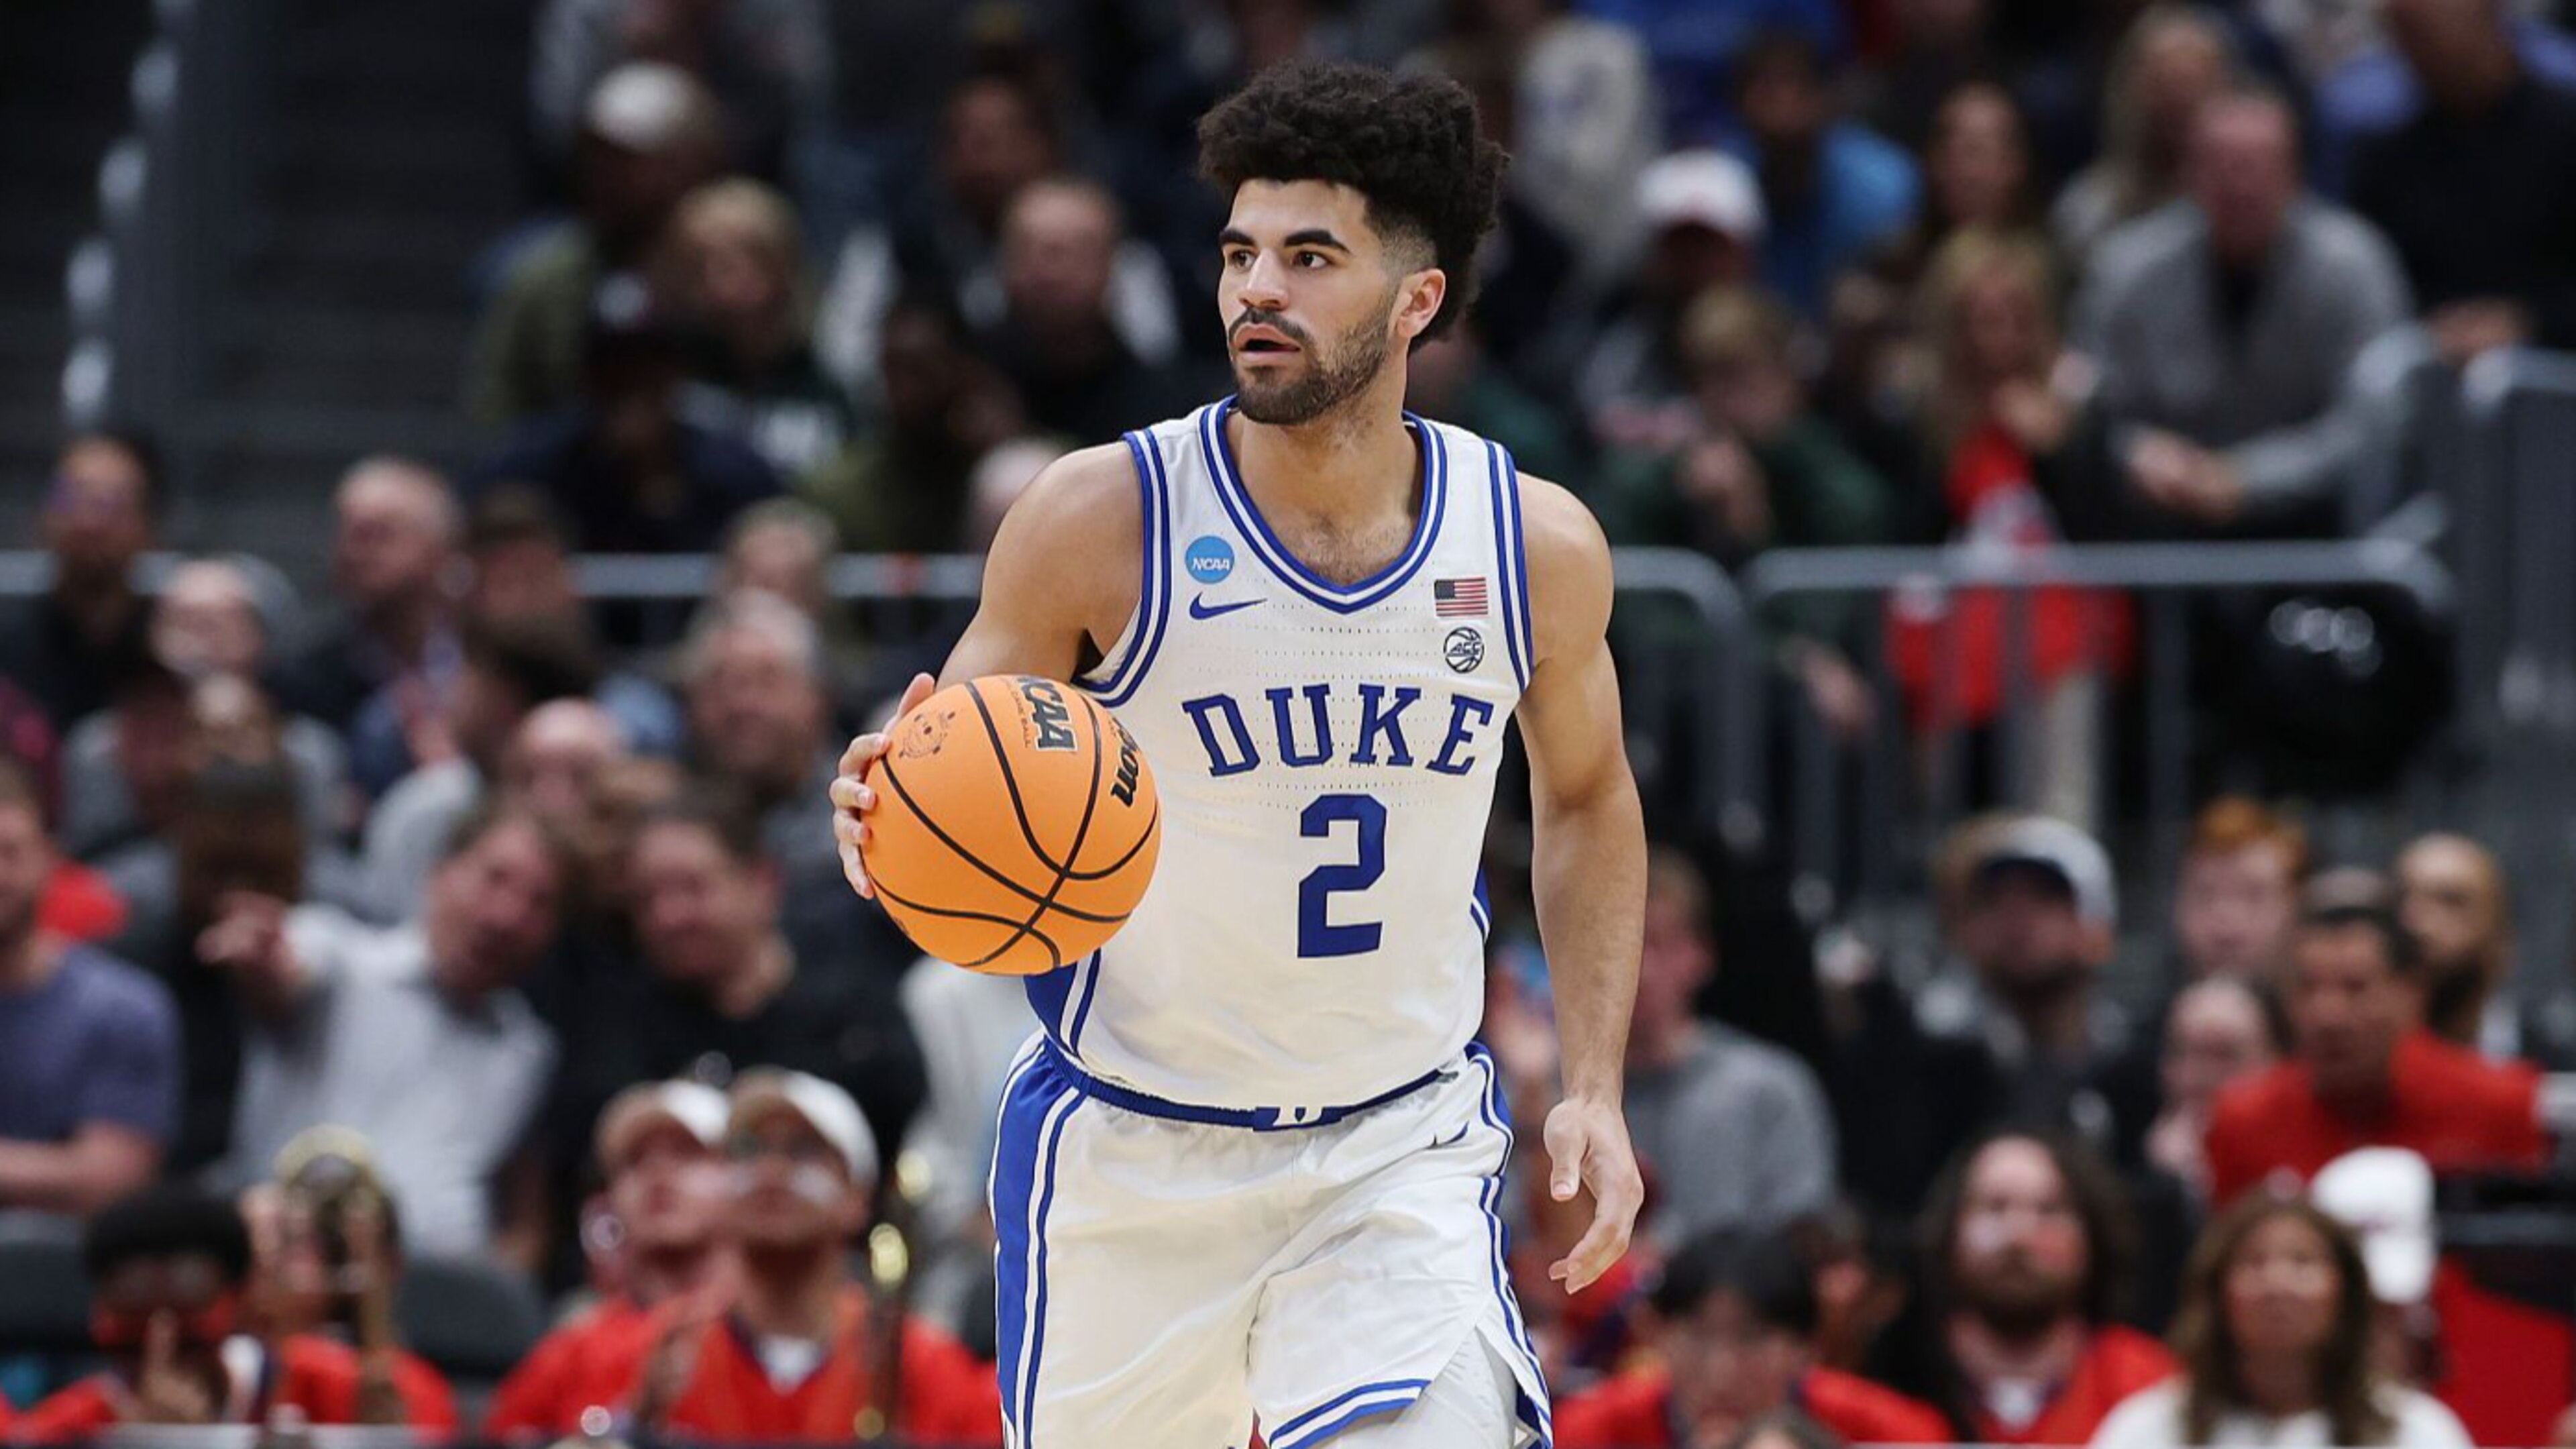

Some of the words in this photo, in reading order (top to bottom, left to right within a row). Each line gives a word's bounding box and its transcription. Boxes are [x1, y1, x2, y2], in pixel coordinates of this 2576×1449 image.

[1192, 557, 1230, 570] NCAA
[1182, 683, 1493, 777] DUKE
[1297, 794, 1387, 958] 2
